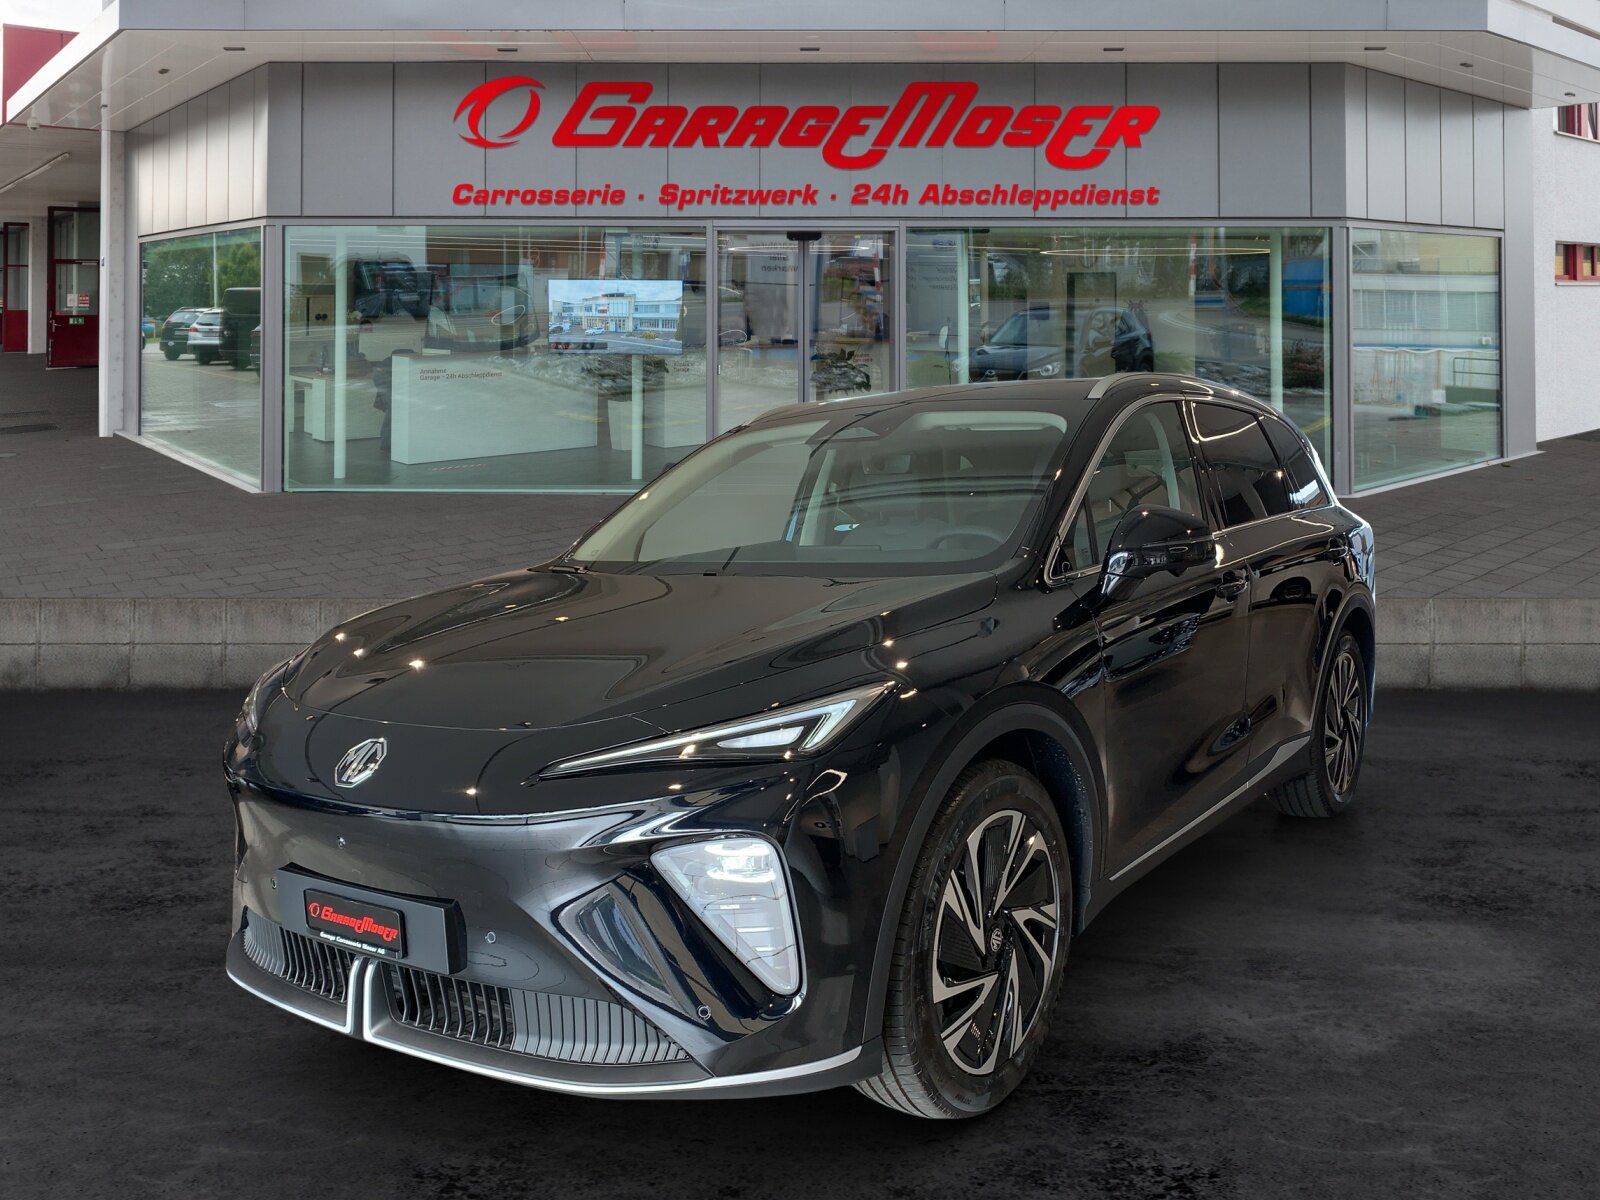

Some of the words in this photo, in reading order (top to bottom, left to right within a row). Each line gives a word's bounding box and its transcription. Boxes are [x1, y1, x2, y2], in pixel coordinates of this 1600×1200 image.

[452, 183, 625, 205] Carrosserie
[658, 183, 818, 209] Spritzwerk
[850, 183, 909, 205] 24h
[918, 183, 1161, 209] Abschleppdienst
[338, 740, 385, 784] MG
